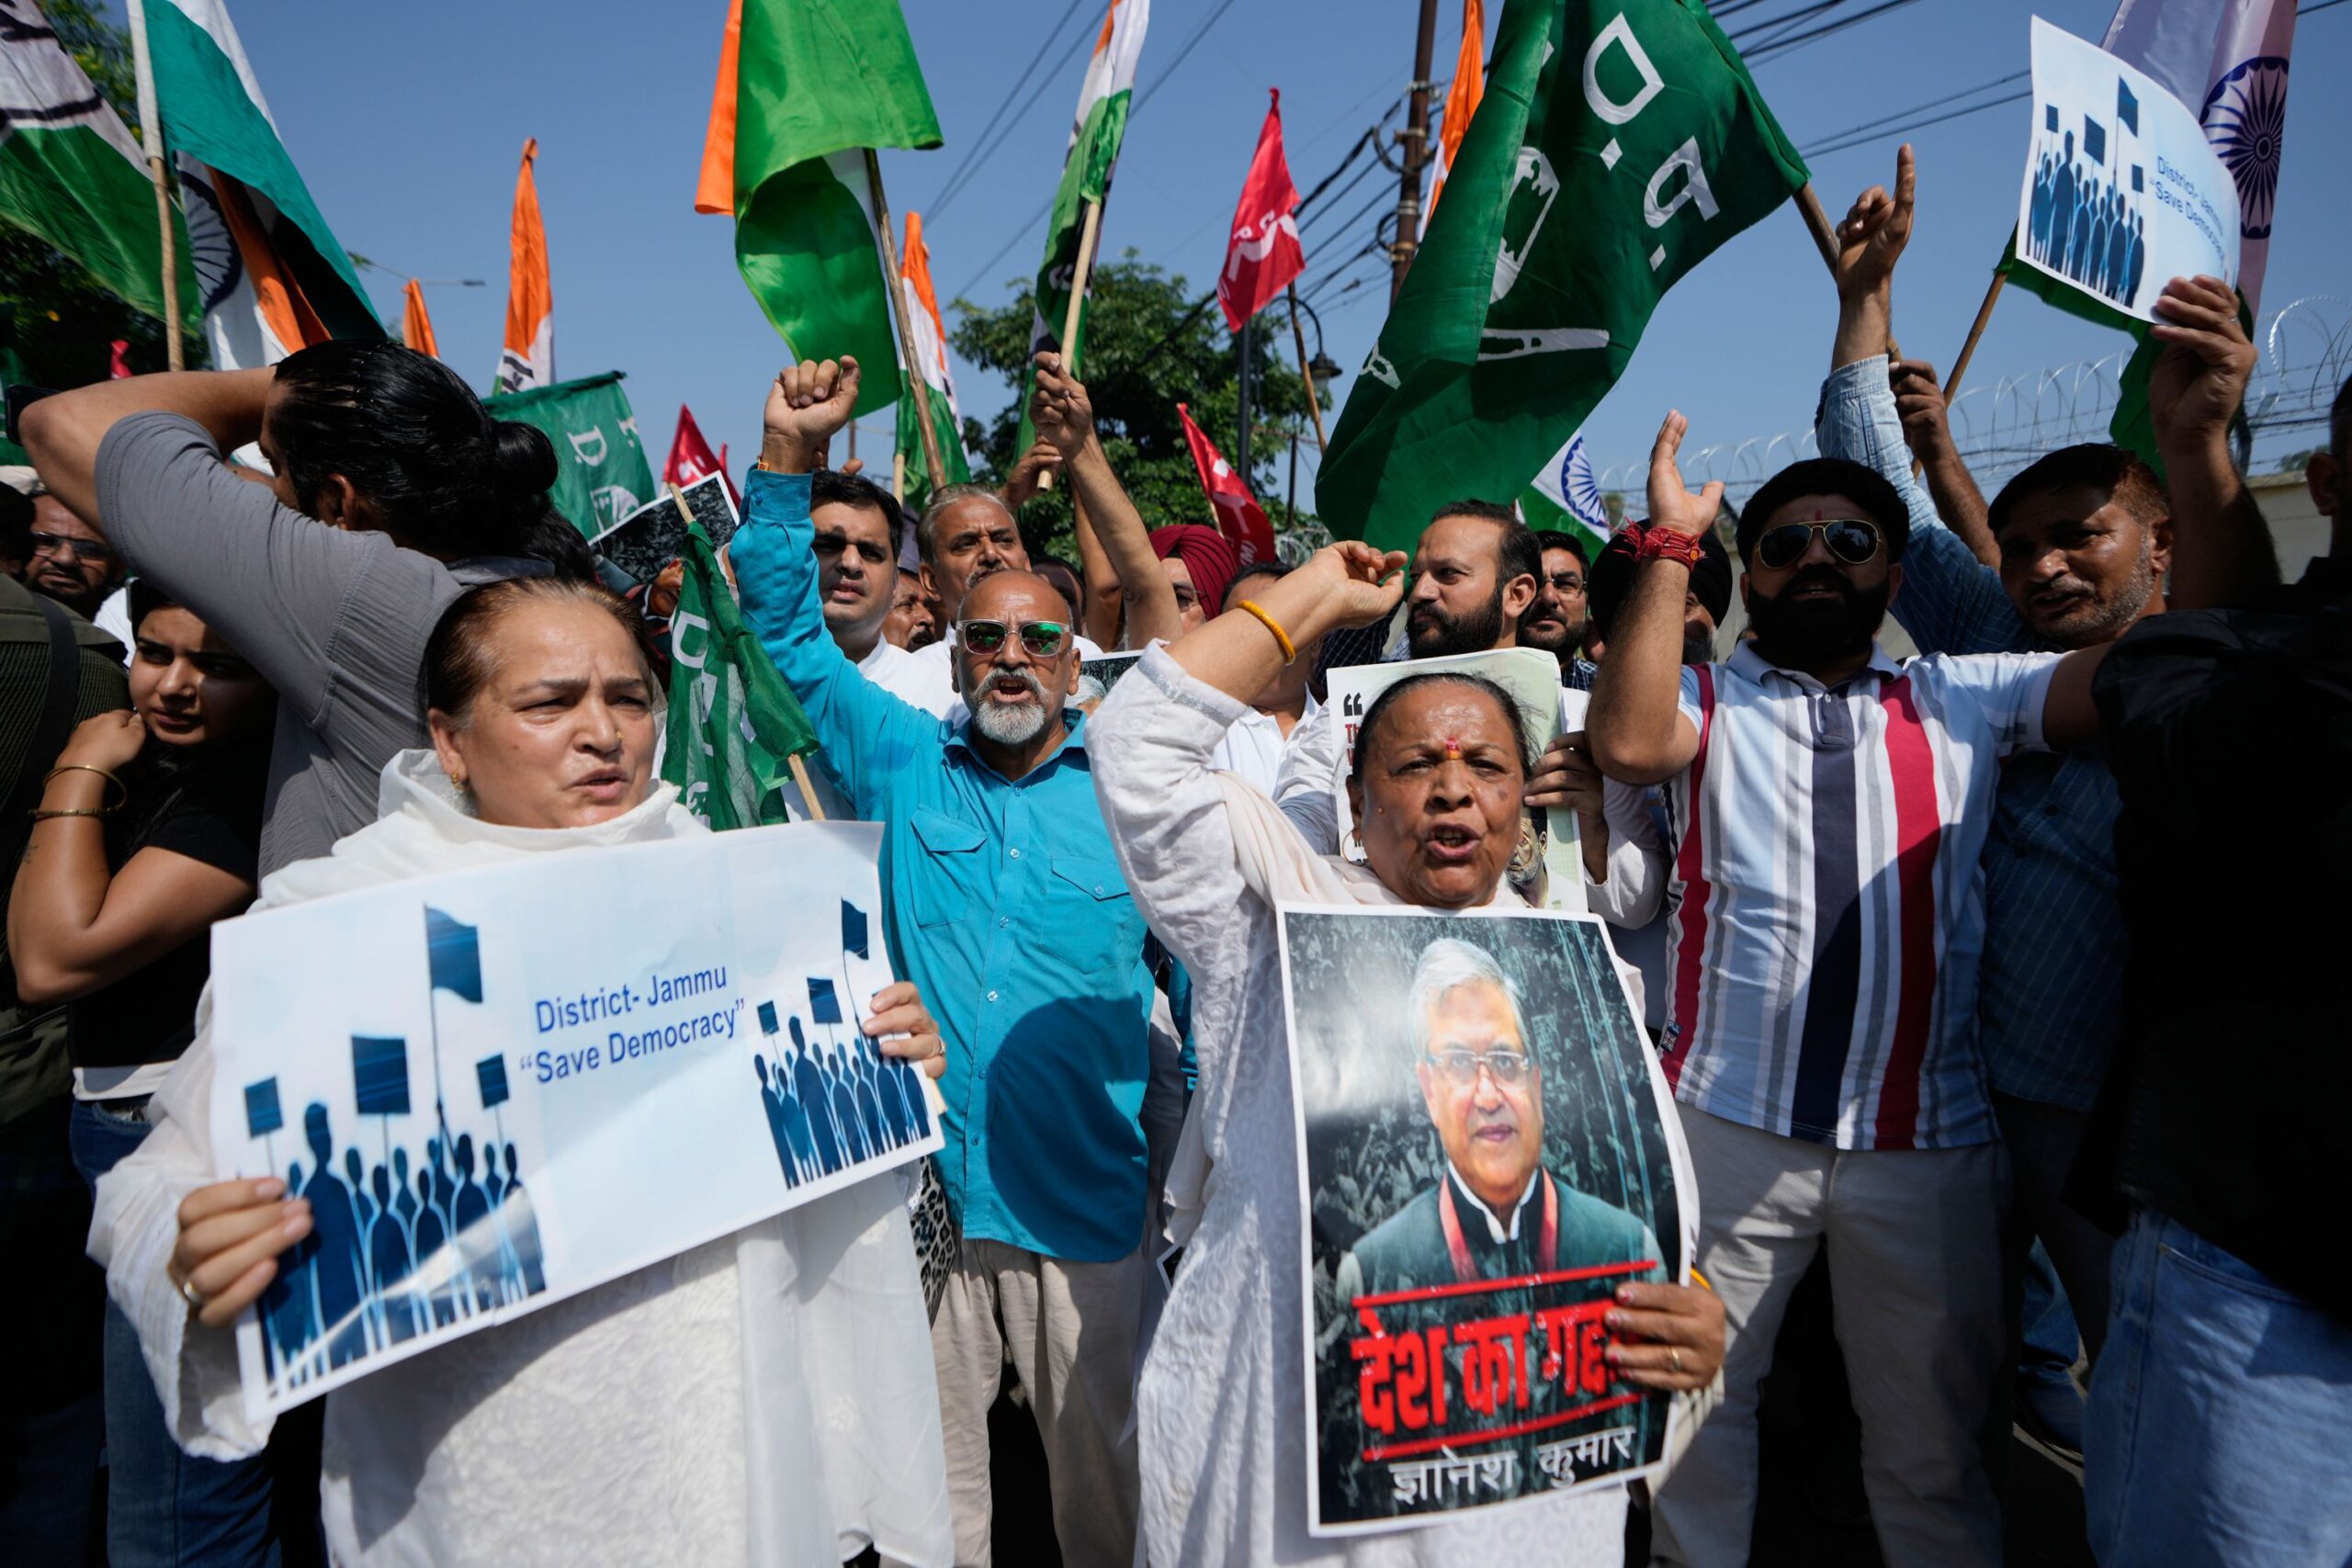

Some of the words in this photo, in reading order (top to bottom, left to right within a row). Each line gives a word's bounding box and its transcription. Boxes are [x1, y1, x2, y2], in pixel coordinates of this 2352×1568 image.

[520, 1046, 600, 1084] “Save
[608, 998, 745, 1064] Democracy”
[535, 983, 640, 1034] District-
[647, 966, 727, 1007] Jammu
[1351, 1307, 1448, 1435] देश
[1453, 1313, 1532, 1416] का
[1388, 1443, 1518, 1505] ज्ञानेश
[1536, 1426, 1636, 1489] कुमार
